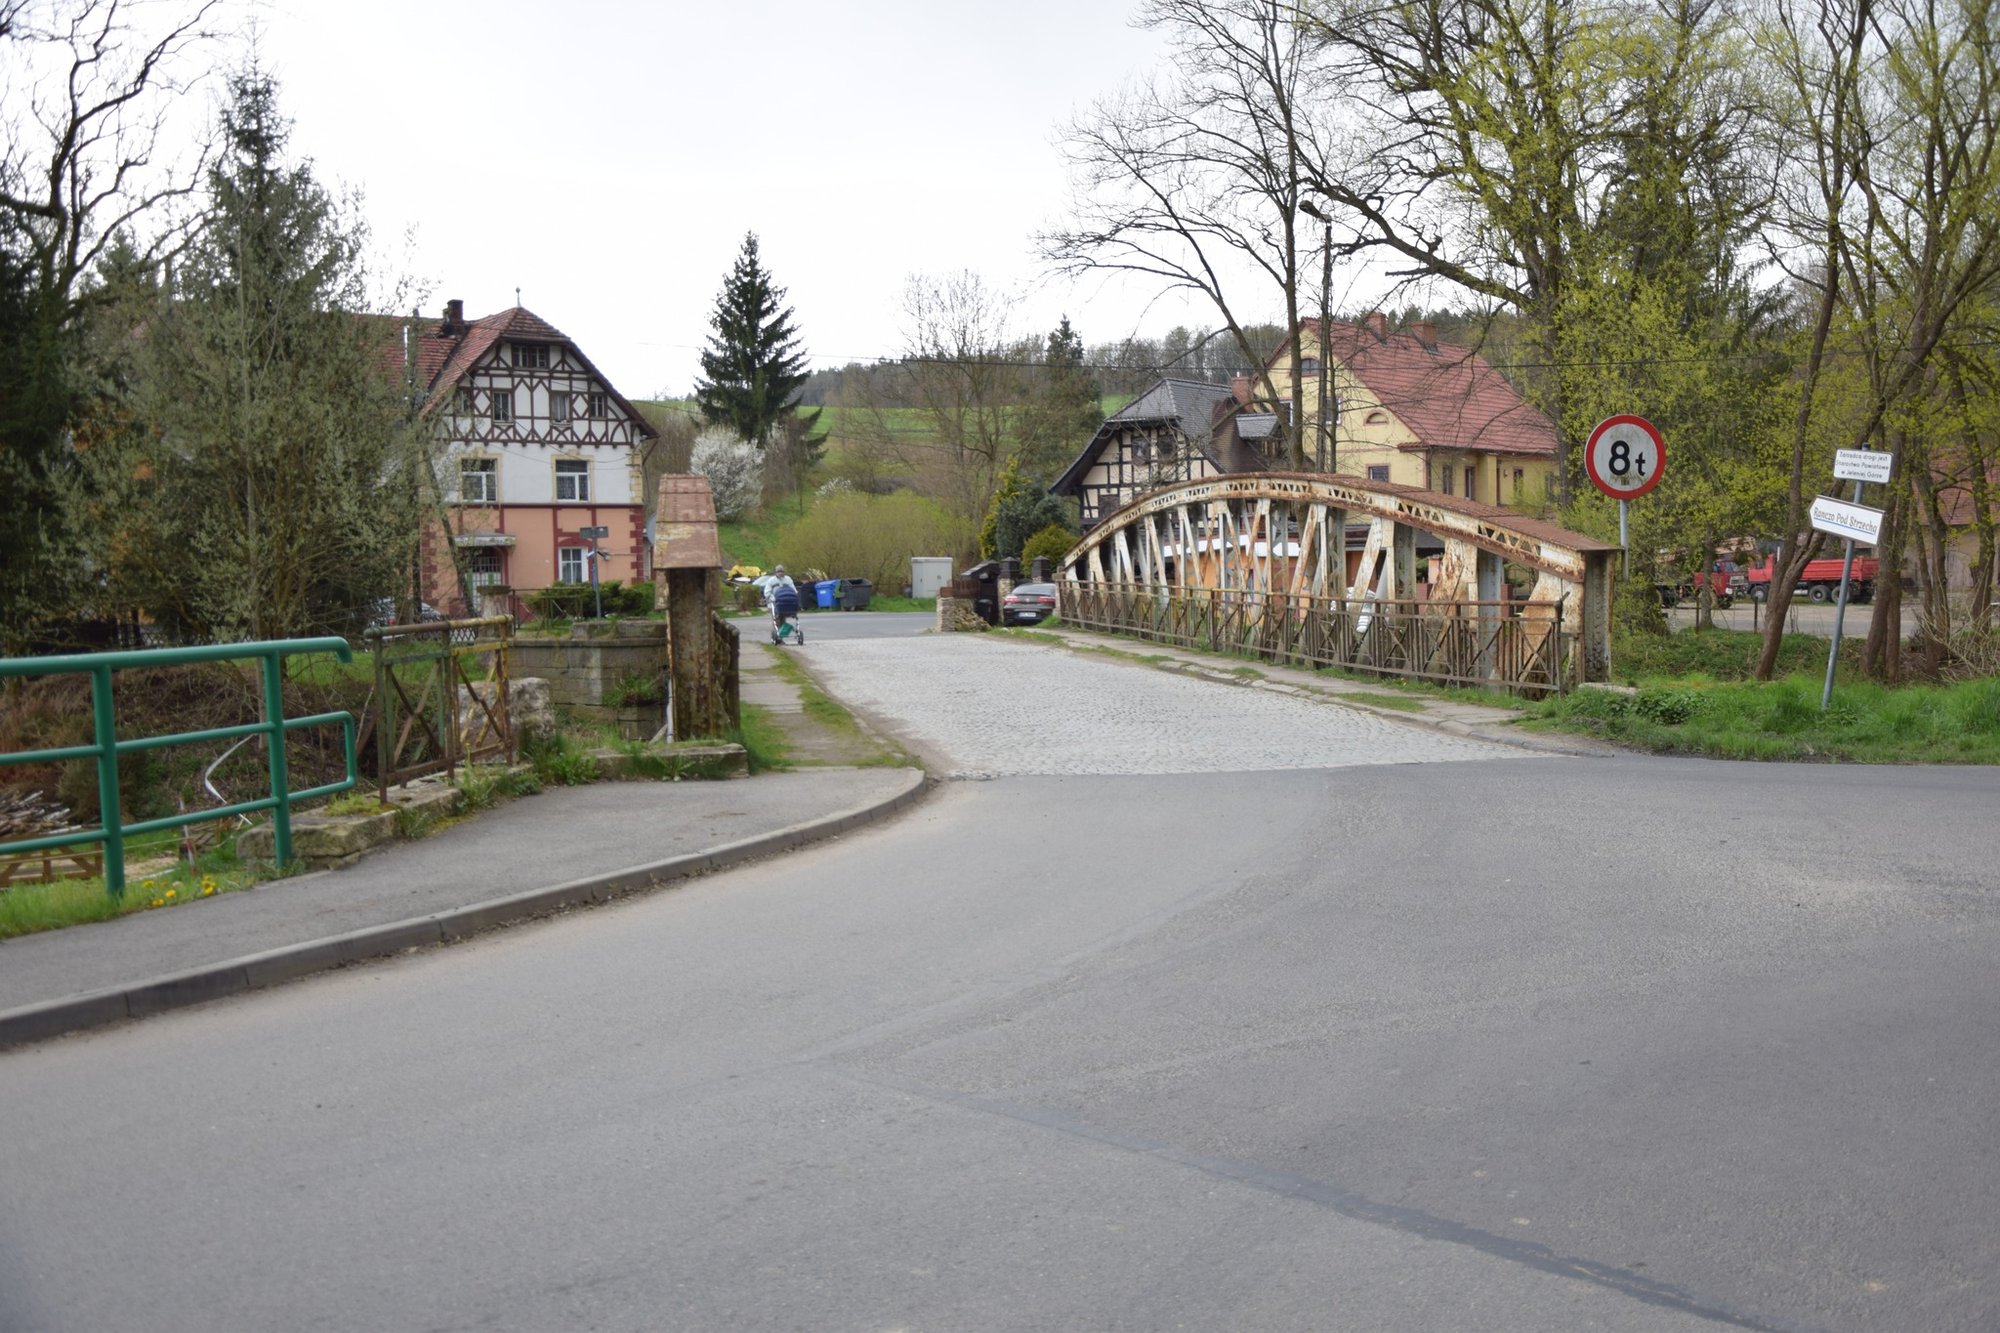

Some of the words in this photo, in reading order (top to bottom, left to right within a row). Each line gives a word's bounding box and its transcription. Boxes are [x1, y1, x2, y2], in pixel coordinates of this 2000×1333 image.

[1608, 440, 1631, 476] 8
[1635, 451, 1646, 477] t
[1813, 506, 1835, 520] Ranczo
[1836, 513, 1849, 525] Pod
